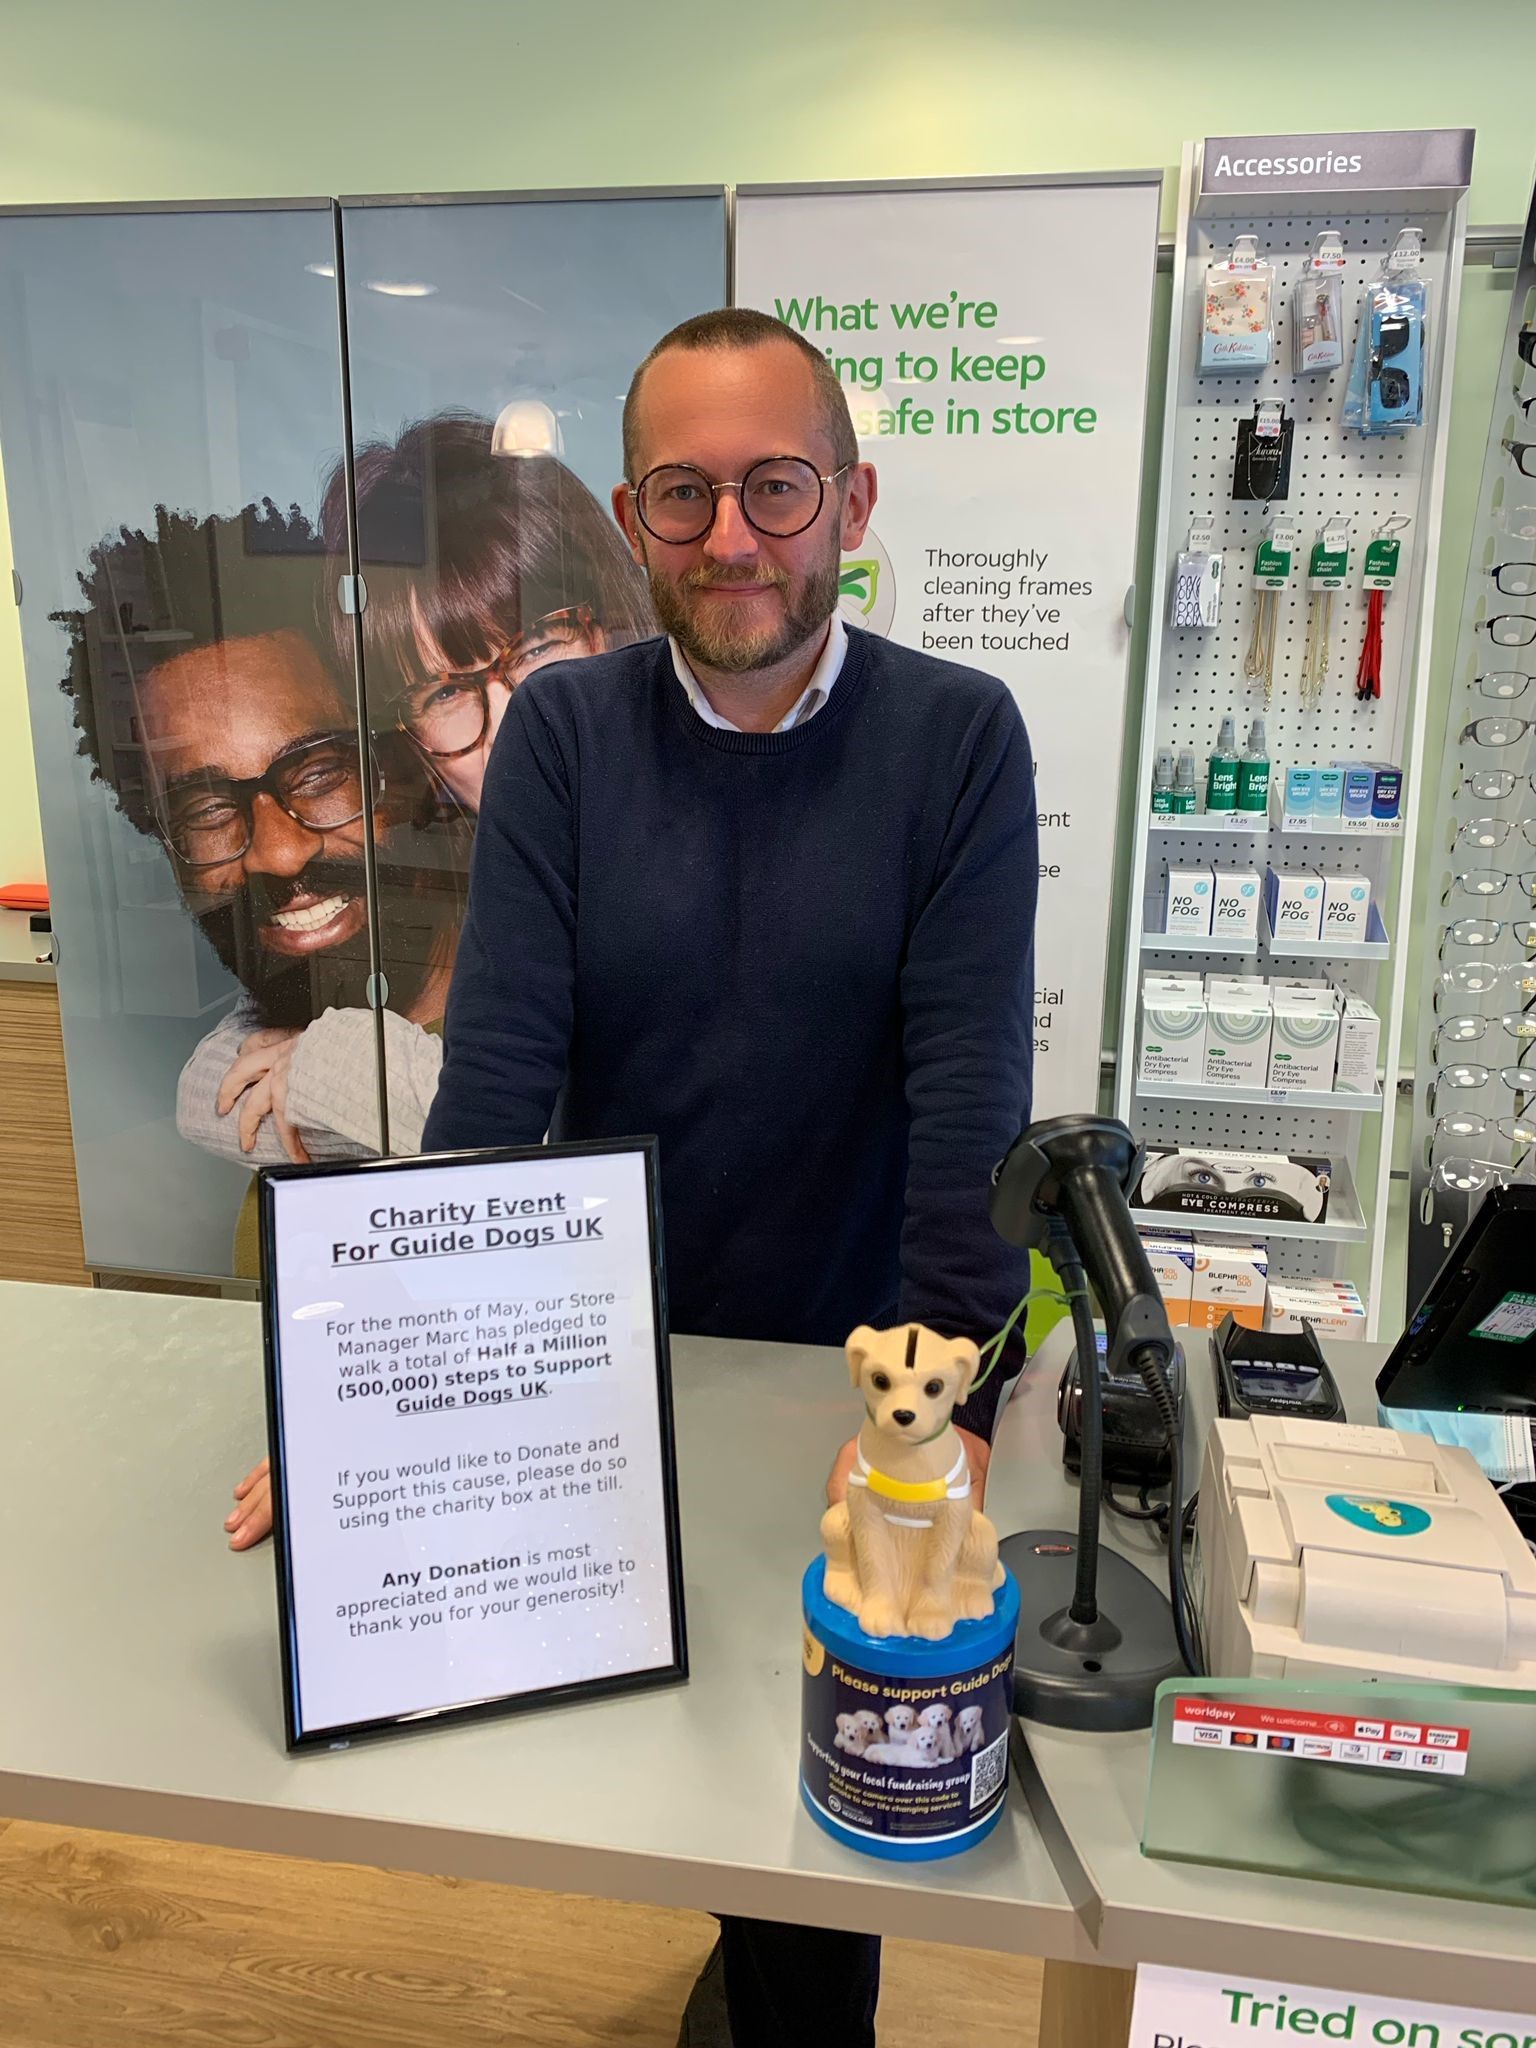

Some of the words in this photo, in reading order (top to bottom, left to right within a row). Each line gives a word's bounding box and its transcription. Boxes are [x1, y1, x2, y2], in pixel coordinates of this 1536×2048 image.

[1214, 150, 1362, 178] Accessories
[1321, 252, 1341, 260] £7.50
[775, 296, 878, 332] What
[890, 289, 999, 330] we're
[826, 347, 884, 392] ing
[895, 351, 939, 383] to
[949, 347, 1046, 390] keep
[856, 398, 934, 437] safe
[946, 398, 980, 435] in
[992, 401, 1098, 436] store
[1192, 534, 1211, 542] £2.50
[1326, 534, 1346, 543] £4.75
[925, 548, 1048, 572] Thoroughly
[923, 575, 1011, 601] cleaning
[1017, 576, 1093, 597] frames
[922, 602, 976, 624] after
[981, 602, 1061, 627] they've
[921, 630, 974, 651] been
[980, 630, 1069, 652] touched
[1214, 773, 1234, 782] Lens
[1250, 774, 1268, 783] Lens
[1213, 781, 1237, 792] Bright
[1172, 896, 1192, 906] NO
[1219, 898, 1239, 907] NO
[1282, 900, 1302, 910] NO
[1328, 902, 1349, 912] NO
[1172, 906, 1200, 916] FOG
[1218, 908, 1246, 918] FOG
[1281, 910, 1309, 920] FOG
[1327, 912, 1356, 922] FOG
[1144, 1061, 1157, 1069] Dry
[1158, 1062, 1171, 1070] Eye
[1145, 1054, 1189, 1063] Antibacterial
[1208, 1058, 1252, 1067] Antibacterial
[1143, 1067, 1178, 1077] Compress
[1206, 1071, 1241, 1080] Compress
[1207, 1065, 1220, 1073] Dry
[1221, 1065, 1234, 1074] Eye
[1272, 1069, 1286, 1077] Dry
[1273, 1063, 1319, 1072] Antibacterial
[1272, 1076, 1307, 1085] Compress
[369, 1202, 475, 1228] Charity
[487, 1193, 566, 1217] Event
[1181, 1198, 1204, 1208] EYE
[1209, 1200, 1280, 1214] COMPRESS
[332, 1241, 379, 1263] For
[390, 1231, 474, 1257] Guide
[485, 1224, 555, 1248] Dogs
[566, 1217, 603, 1238] UK
[1236, 1280, 1252, 1288] DUO
[326, 1321, 355, 1336] For
[361, 1317, 392, 1333] the
[398, 1308, 457, 1329] month
[464, 1304, 481, 1321] of
[487, 1302, 528, 1319] May,
[535, 1298, 564, 1313] our
[569, 1292, 615, 1308] Store
[338, 1335, 420, 1357] Manager
[426, 1330, 469, 1346] Marc
[476, 1325, 507, 1340] has
[513, 1313, 584, 1339] pledged
[590, 1312, 607, 1327] to
[339, 1359, 381, 1378] walk
[388, 1360, 398, 1372] a
[405, 1350, 447, 1370] total
[453, 1347, 471, 1364] of
[478, 1342, 517, 1361] Half
[524, 1343, 535, 1355] a
[542, 1333, 607, 1353] Million
[337, 1373, 438, 1402] (500,000)
[445, 1368, 499, 1386] steps
[506, 1364, 527, 1378] to
[533, 1352, 612, 1375] Support
[396, 1393, 455, 1413] Guide
[464, 1387, 513, 1405] Dogs
[520, 1380, 552, 1398] UK.
[337, 1470, 349, 1487] If
[356, 1468, 389, 1488] you
[396, 1457, 450, 1478] would
[457, 1453, 488, 1470] like
[494, 1450, 511, 1465] to
[518, 1441, 581, 1461] Donate
[588, 1433, 619, 1452] and
[333, 1486, 407, 1509] Support
[413, 1480, 446, 1498] this
[452, 1474, 510, 1492] cause,
[517, 1464, 575, 1486] please
[581, 1458, 602, 1474] do
[608, 1456, 627, 1471] so
[339, 1511, 389, 1530] using
[396, 1505, 426, 1521] the
[432, 1495, 495, 1516] charity
[501, 1490, 533, 1506] box
[539, 1485, 557, 1500] at
[563, 1481, 591, 1497] the
[597, 1475, 623, 1493] till.
[382, 1571, 421, 1588] Any
[429, 1555, 521, 1580] Donation
[527, 1550, 541, 1566] is
[547, 1542, 591, 1563] most
[336, 1585, 447, 1619] appreciated
[454, 1579, 487, 1599] and
[493, 1577, 519, 1592] we
[525, 1565, 577, 1587] would
[583, 1562, 613, 1578] like
[618, 1558, 635, 1573] to
[349, 1615, 403, 1637] thank
[409, 1611, 442, 1632] you
[449, 1605, 474, 1621] for
[480, 1598, 520, 1620] your
[526, 1579, 624, 1612] generosity!
[832, 1664, 879, 1695] Please
[882, 1685, 948, 1703] support
[950, 1674, 990, 1695] Guide
[1184, 1706, 1236, 1721] worldpay
[1260, 1714, 1275, 1725] We
[1198, 1731, 1219, 1740] VISA
[841, 1766, 862, 1780] your
[863, 1772, 886, 1788] local
[887, 1776, 944, 1792] fundraising
[945, 1773, 970, 1789] group
[1222, 1989, 1355, 2040] Tried
[1372, 2019, 1441, 2048] on
